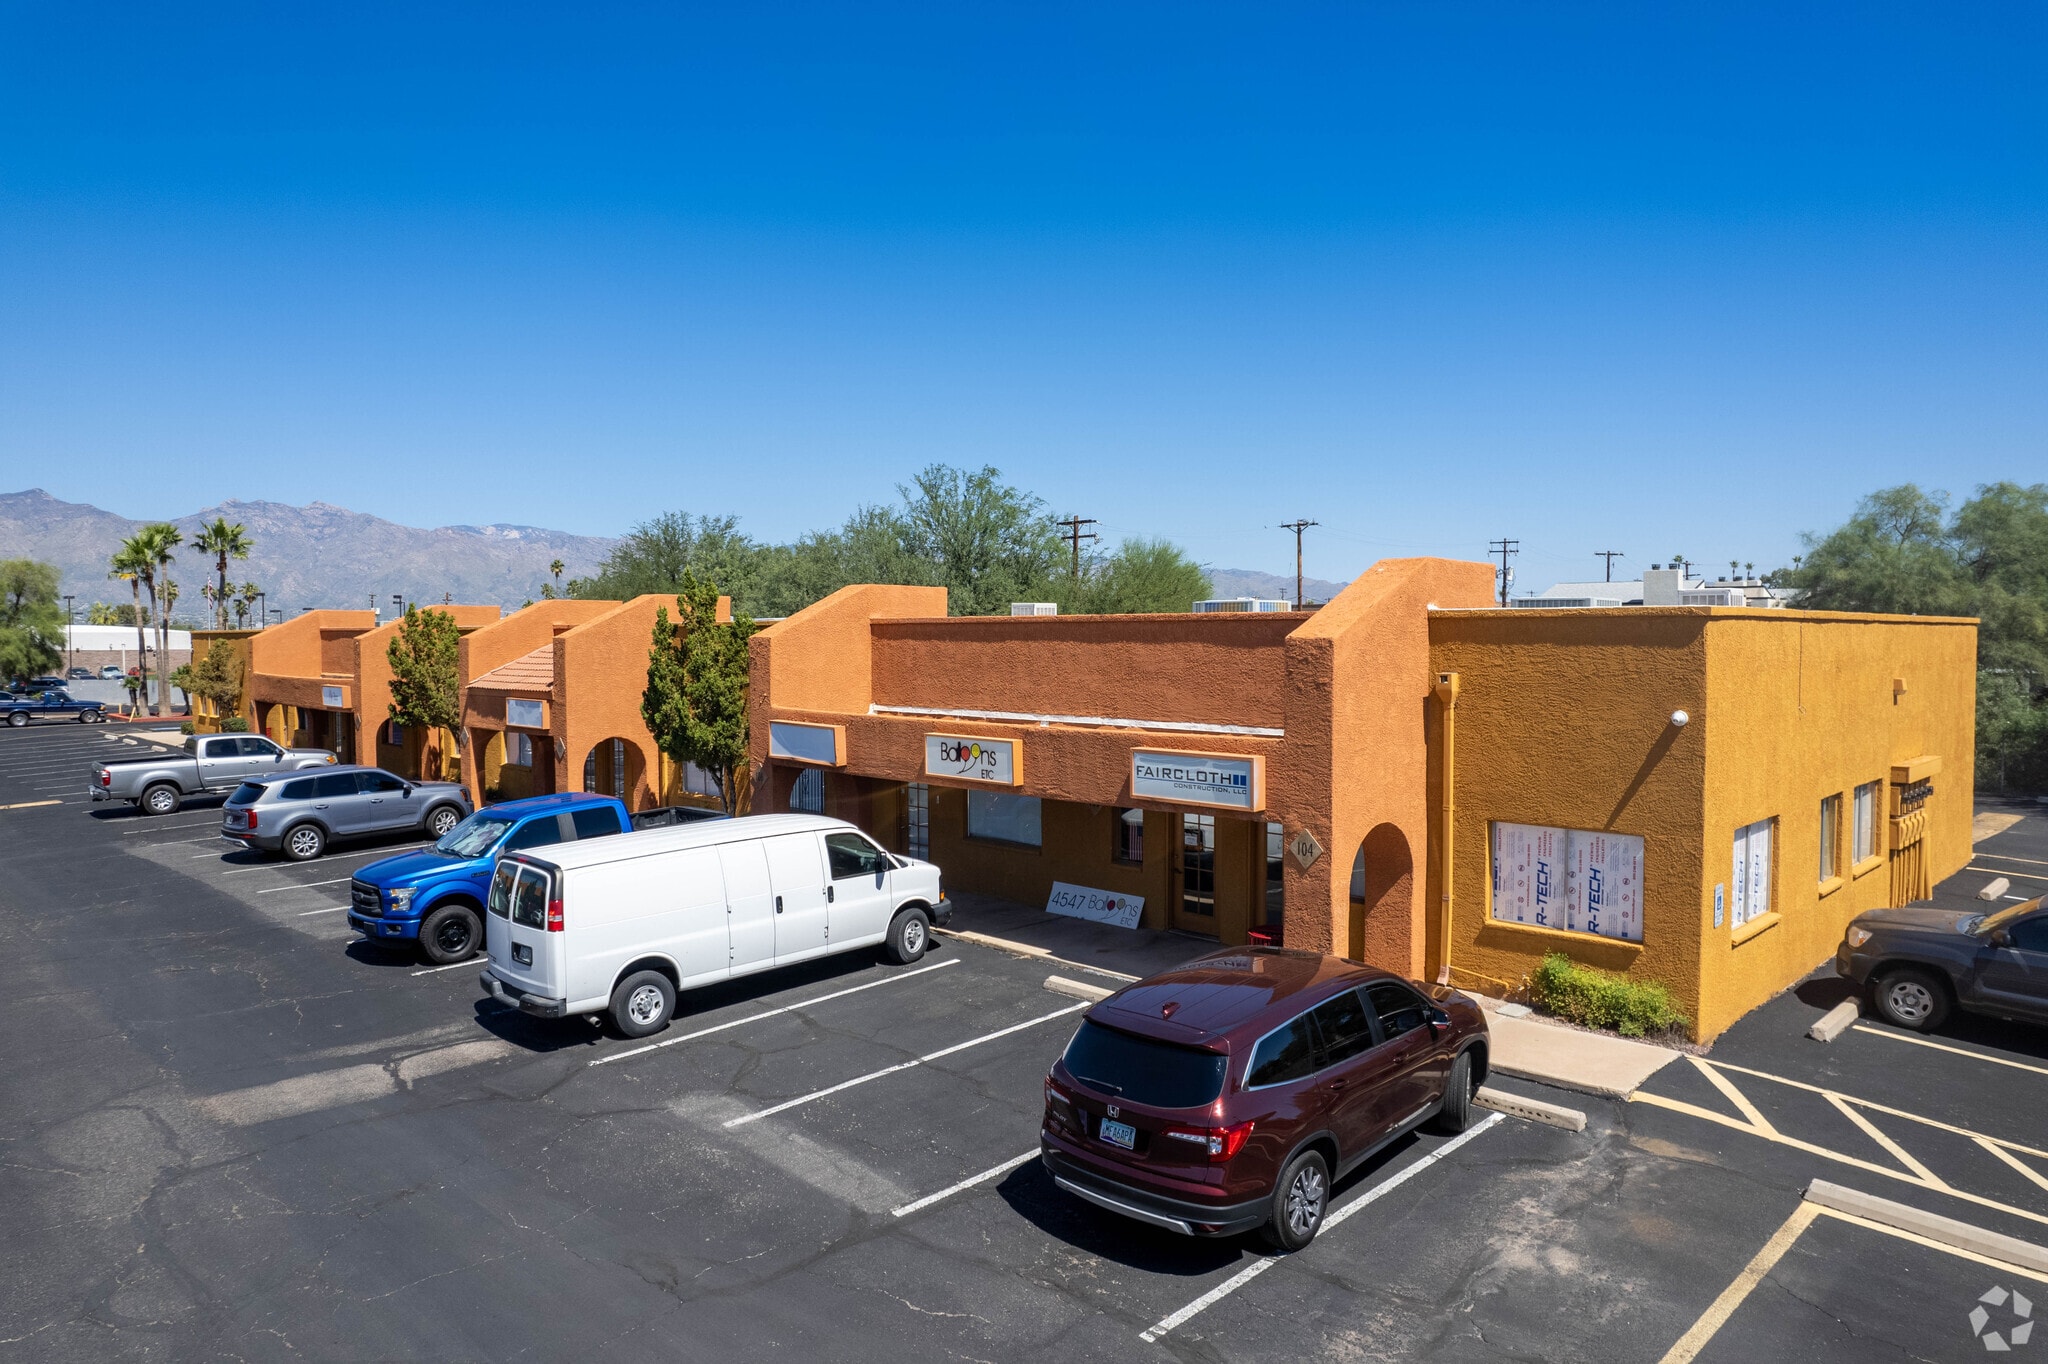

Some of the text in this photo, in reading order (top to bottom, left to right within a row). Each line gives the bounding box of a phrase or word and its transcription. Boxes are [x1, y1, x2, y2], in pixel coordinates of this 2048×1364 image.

[980, 769, 994, 780] ETC
[1136, 765, 1232, 785] FAIRCLOTH
[1173, 782, 1231, 794] CONSTRUCTION,
[1297, 842, 1313, 857] 104
[1051, 891, 1087, 910] 4547
[1536, 861, 1549, 926] R-TECH
[1588, 867, 1602, 935] R-TECH
[1120, 916, 1134, 926] ETC
